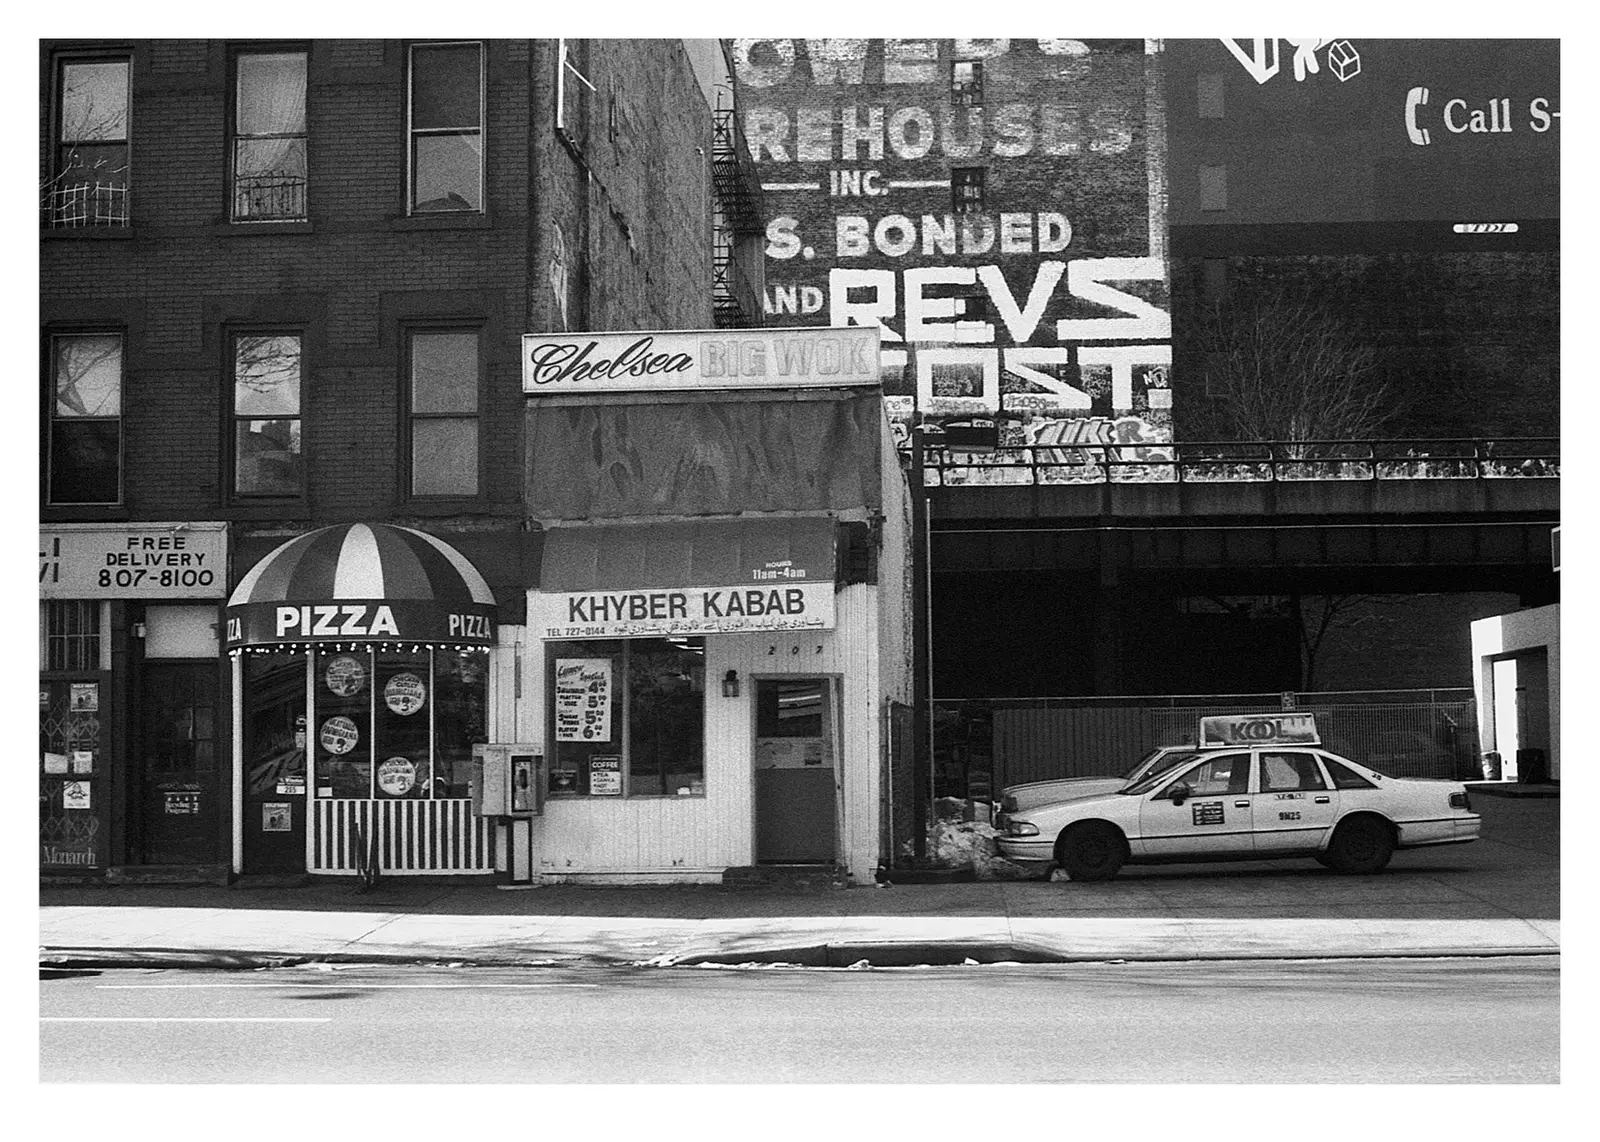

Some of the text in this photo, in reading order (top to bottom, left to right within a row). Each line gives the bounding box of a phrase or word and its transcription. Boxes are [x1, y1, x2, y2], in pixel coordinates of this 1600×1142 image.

[1444, 98, 1512, 133] Call
[830, 170, 888, 196] INC.
[765, 212, 1072, 259] S. BONDED
[829, 257, 1171, 343] REVS
[531, 336, 870, 385] Chelsea BIG WOK
[128, 537, 186, 550] FREE
[107, 553, 205, 566] DELIVERY
[99, 569, 214, 588] 807-8100
[752, 568, 806, 580] 11am-4am
[568, 588, 805, 623] KHYBER KABAB
[276, 605, 400, 637] PIZZA
[449, 613, 492, 639] PIZZA
[546, 627, 605, 637] TEL 727-0144
[1230, 719, 1283, 741] KOOL
